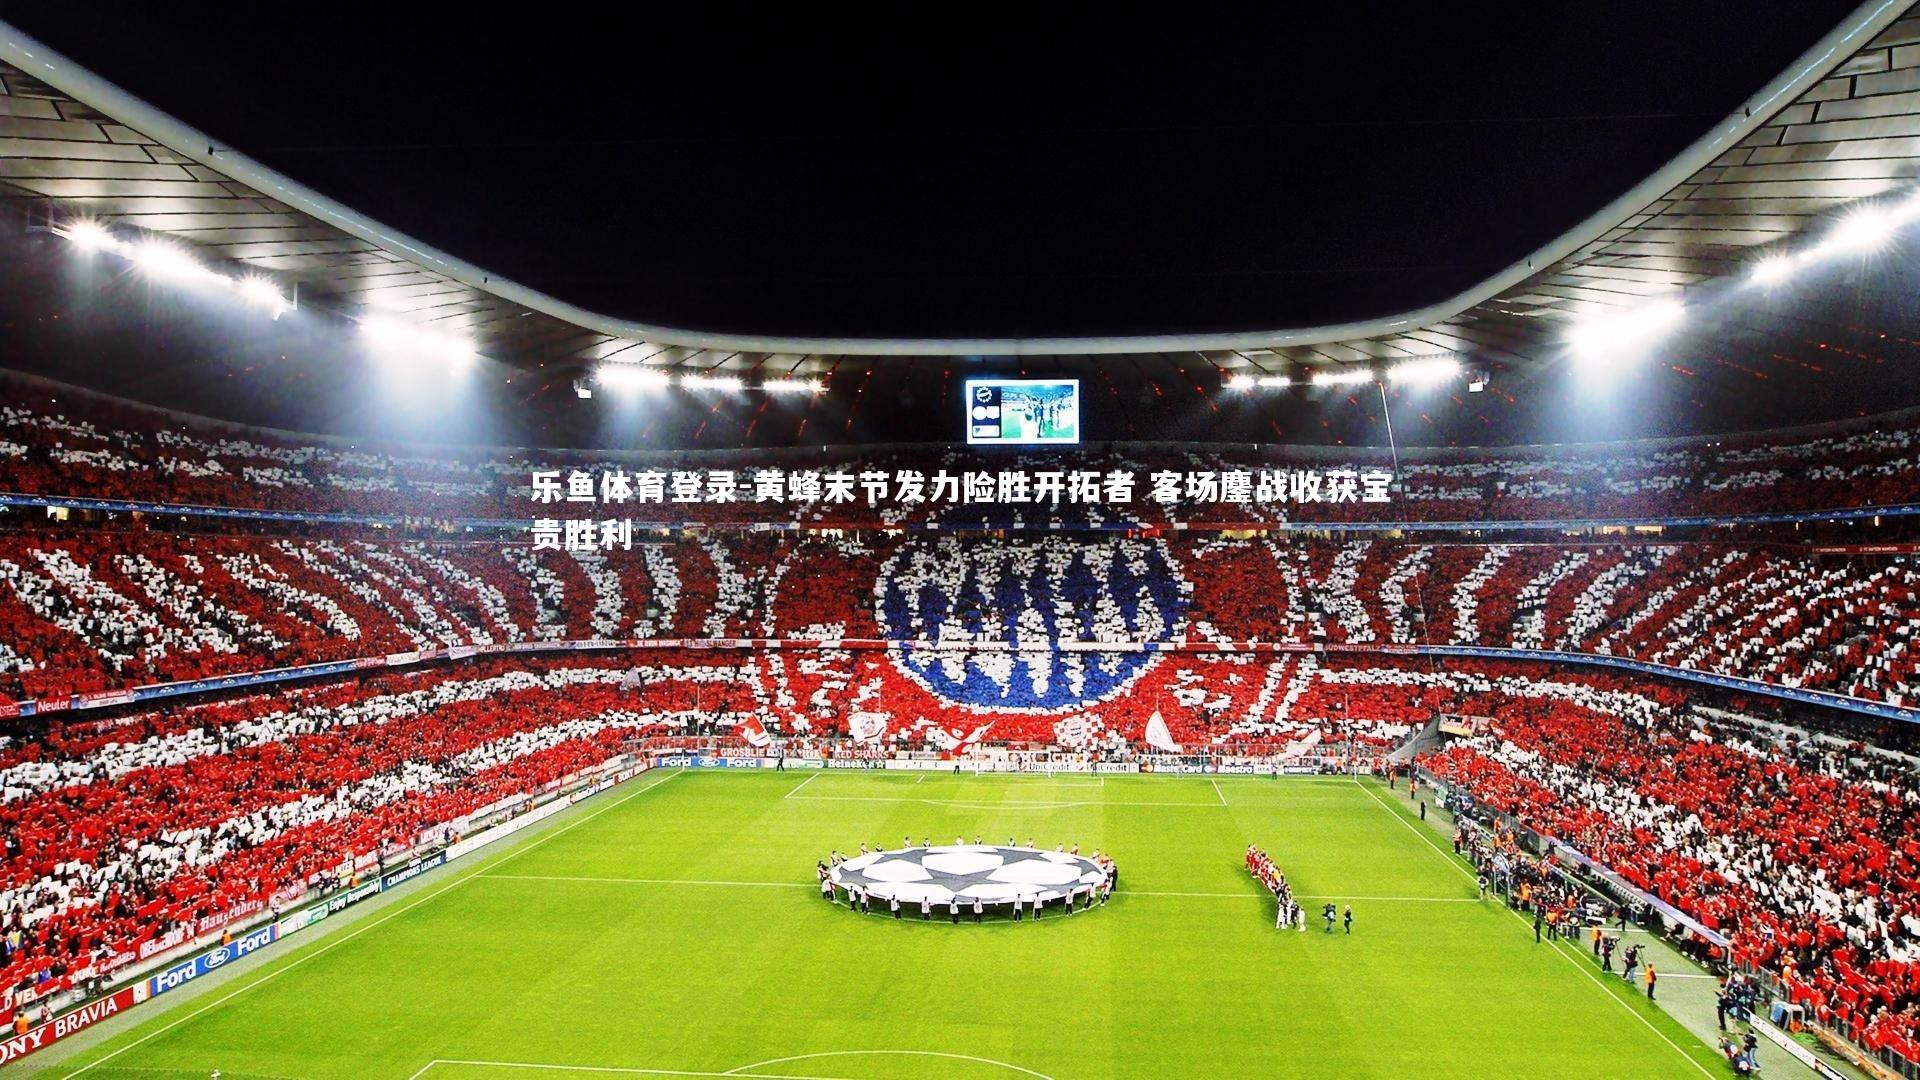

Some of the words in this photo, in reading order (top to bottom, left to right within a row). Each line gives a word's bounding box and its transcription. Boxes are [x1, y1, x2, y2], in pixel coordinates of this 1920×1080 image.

[37, 700, 70, 712] Neuler
[726, 758, 757, 768] Ford
[387, 864, 421, 886] CHAMPIONS
[421, 856, 442, 872] LEAGUE
[329, 897, 347, 911] Enjoy
[237, 925, 271, 956] Ford
[156, 960, 197, 993] Ford
[0, 1027, 46, 1064] ONY
[55, 997, 118, 1038] BRAVIA
